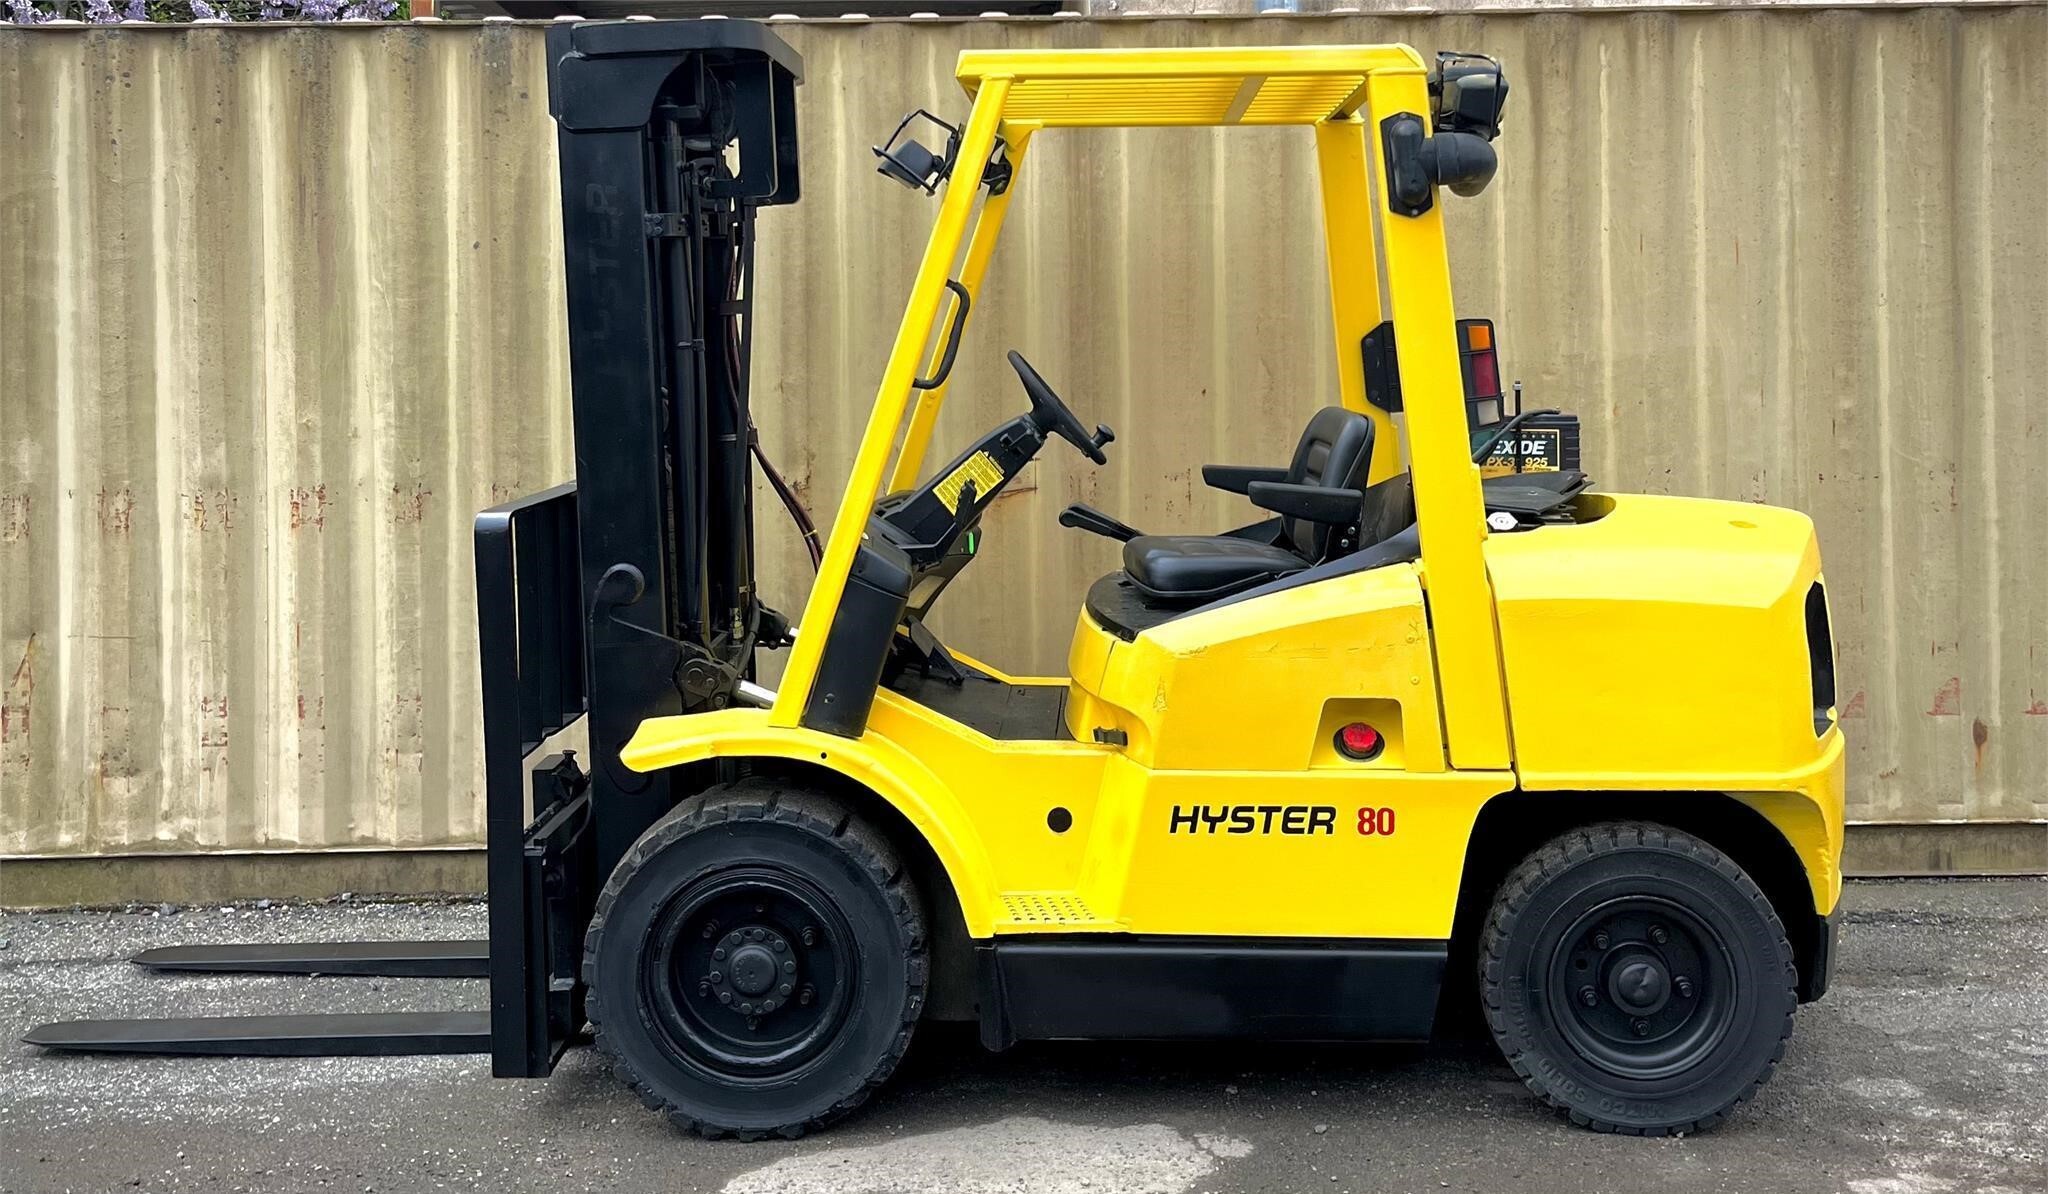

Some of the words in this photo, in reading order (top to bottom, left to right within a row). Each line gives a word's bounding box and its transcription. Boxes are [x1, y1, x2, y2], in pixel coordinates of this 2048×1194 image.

[1493, 440, 1548, 455] EXIDE
[1525, 457, 1549, 468] 925
[1169, 805, 1336, 835] HYSTER
[1357, 807, 1395, 836] 80
